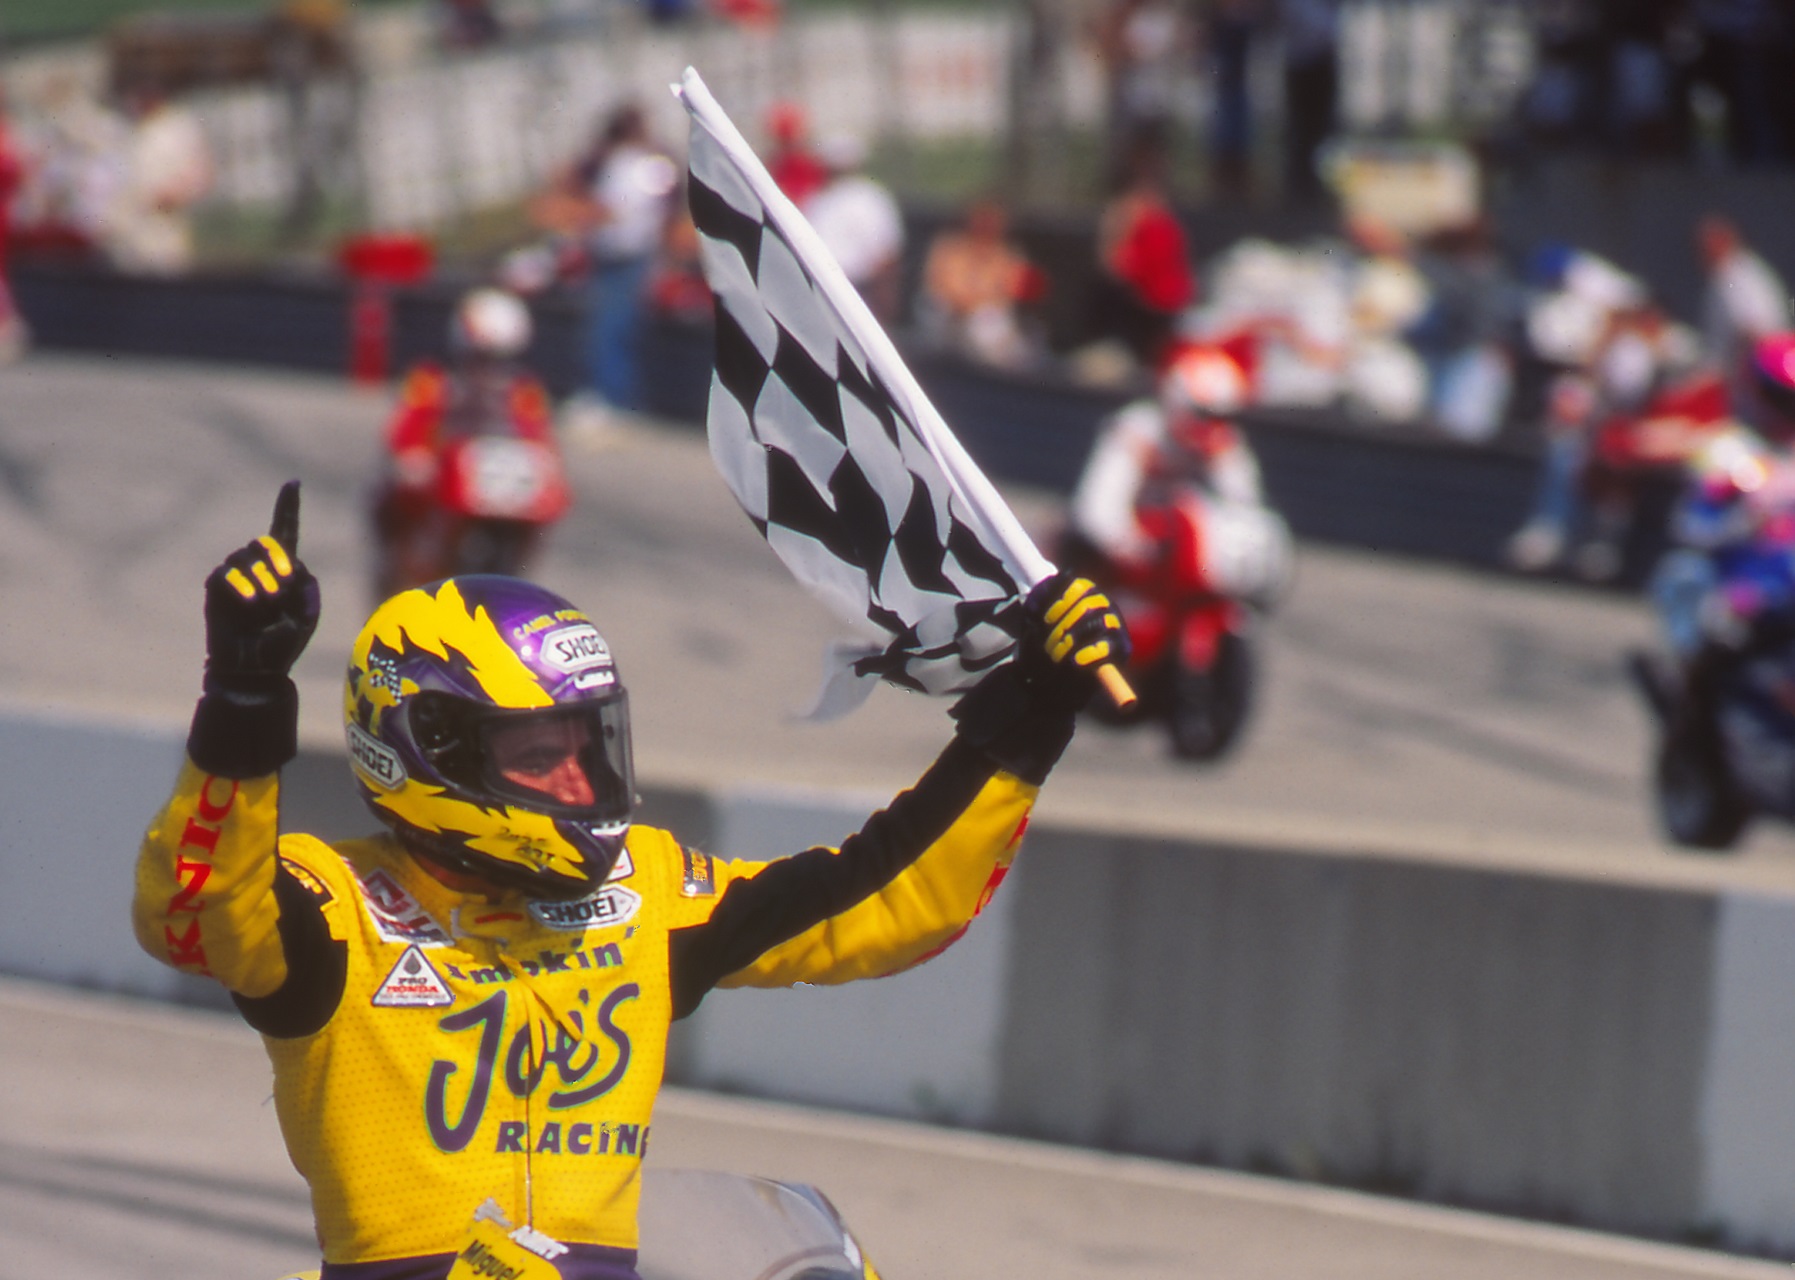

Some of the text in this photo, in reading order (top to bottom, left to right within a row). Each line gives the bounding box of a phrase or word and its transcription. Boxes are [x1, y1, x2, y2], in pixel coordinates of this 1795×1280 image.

[555, 634, 606, 663] SHOE
[539, 895, 618, 924] SHOEI
[386, 985, 439, 994] HONDA
